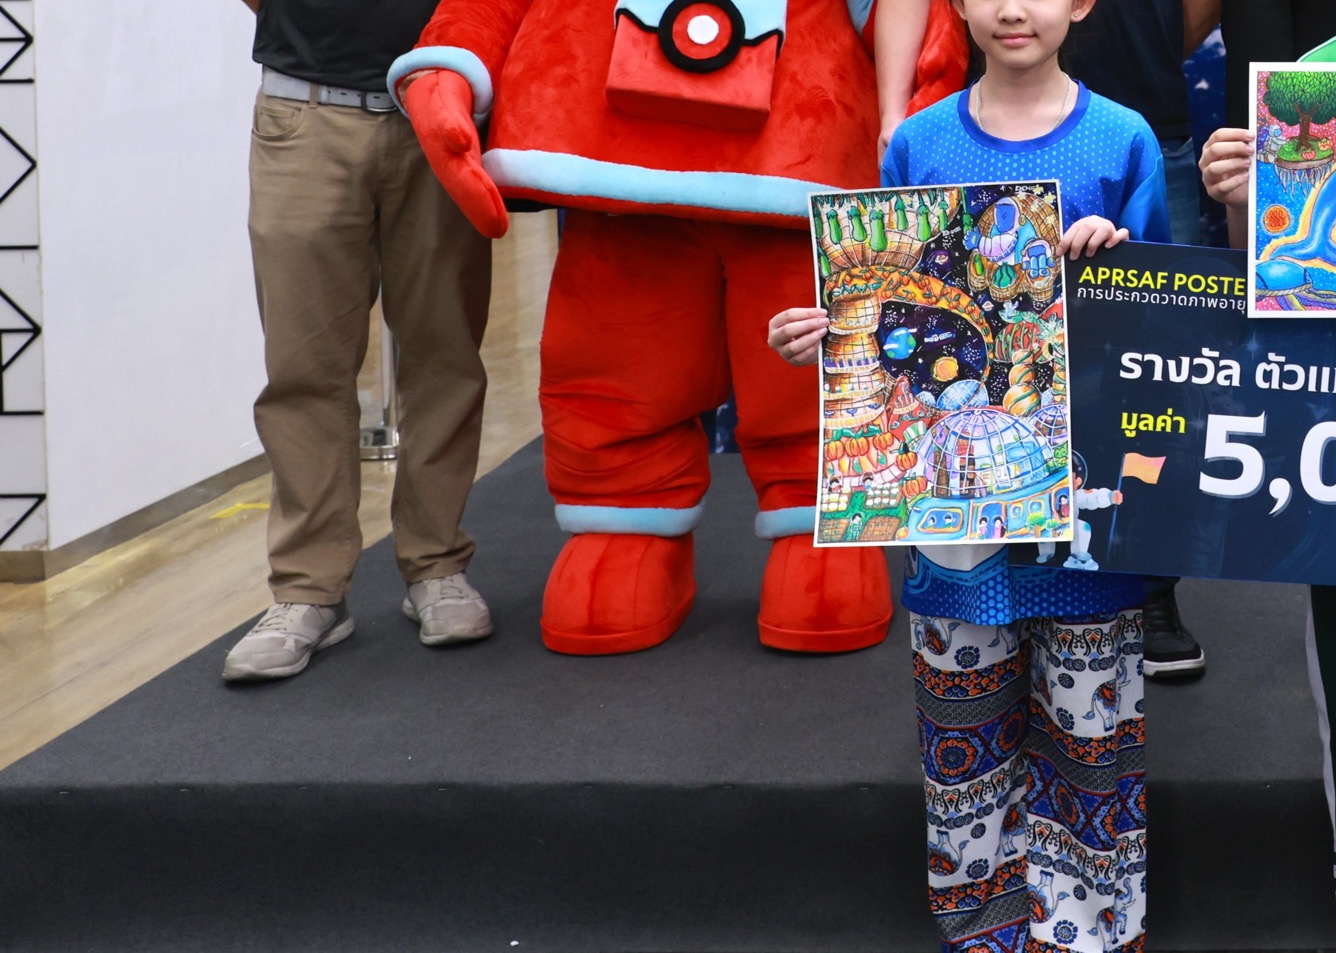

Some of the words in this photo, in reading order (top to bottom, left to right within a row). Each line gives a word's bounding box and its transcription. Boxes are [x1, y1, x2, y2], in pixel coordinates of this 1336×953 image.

[1078, 265, 1169, 291] APRSAF
[1173, 273, 1247, 297] POSTE
[1077, 286, 1247, 315] การประกวดวาดภาพอายุ
[1119, 347, 1241, 389] รางวัล
[1120, 408, 1187, 439] มูลค่า
